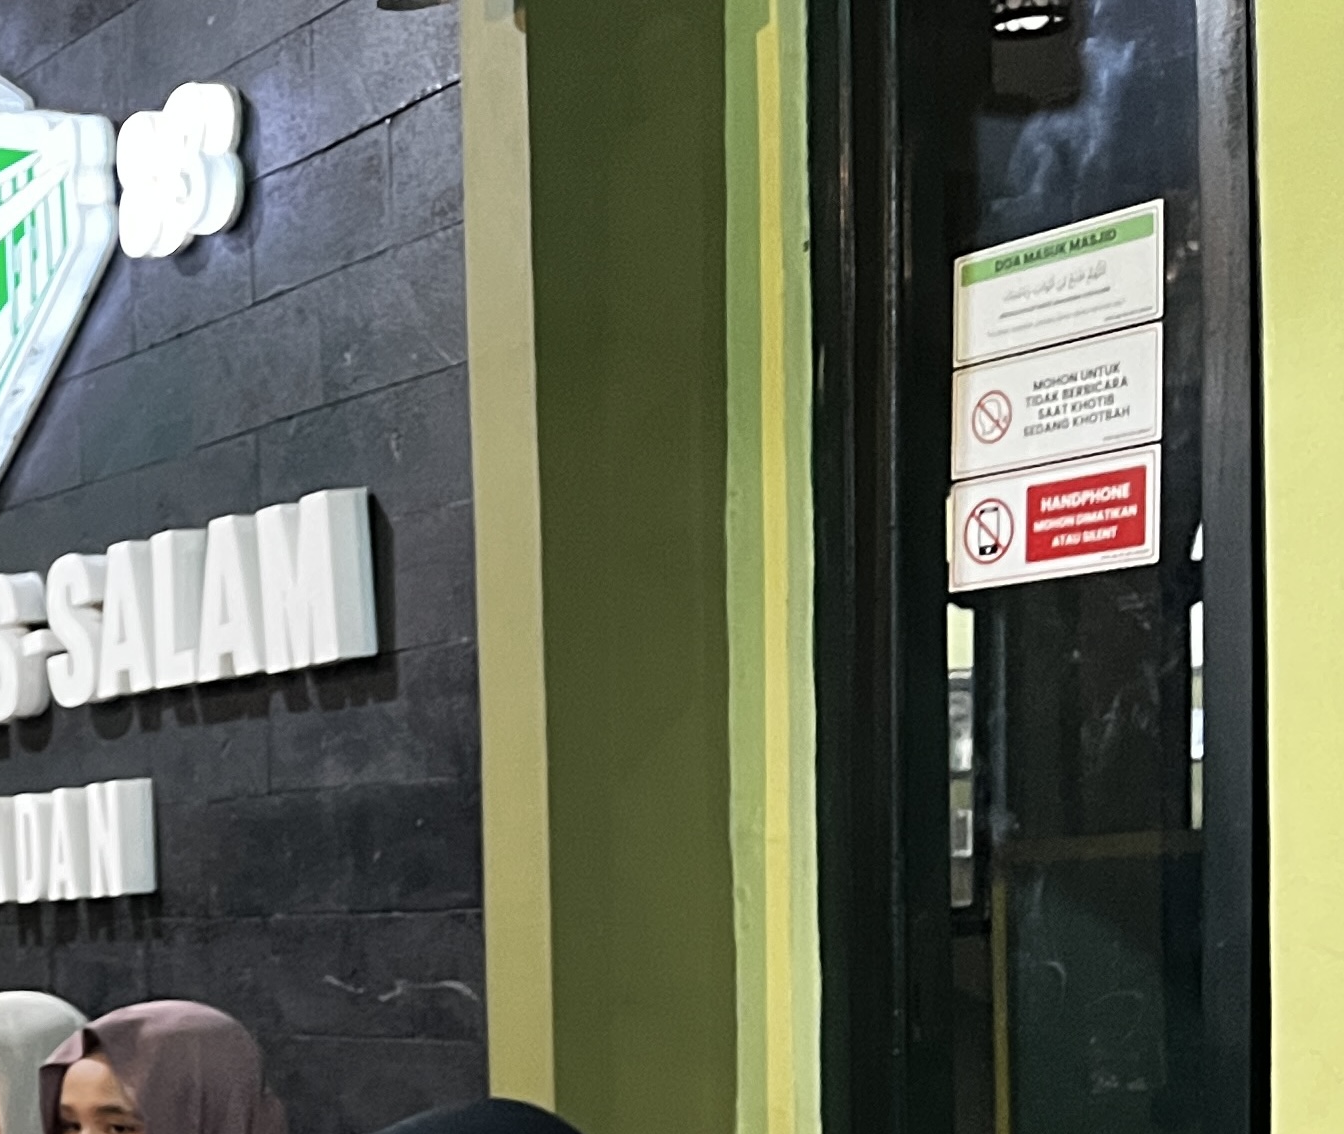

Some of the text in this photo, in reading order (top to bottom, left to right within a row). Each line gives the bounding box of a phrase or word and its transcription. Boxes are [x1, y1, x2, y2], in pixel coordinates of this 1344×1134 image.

[995, 227, 1118, 273] DOA MASUK MASJID
[1025, 375, 1129, 407] TIDAK BERBICARA
[1033, 361, 1121, 392] MOHON UNTUK
[1023, 405, 1131, 437] SEDANG KHOTBAH
[1038, 393, 1115, 420] SAAT KHOTIB
[1040, 482, 1132, 513] HANDPHONE
[1033, 503, 1138, 533] MOHON DIMATIKAN
[1051, 525, 1119, 549] ATAU SILENT
